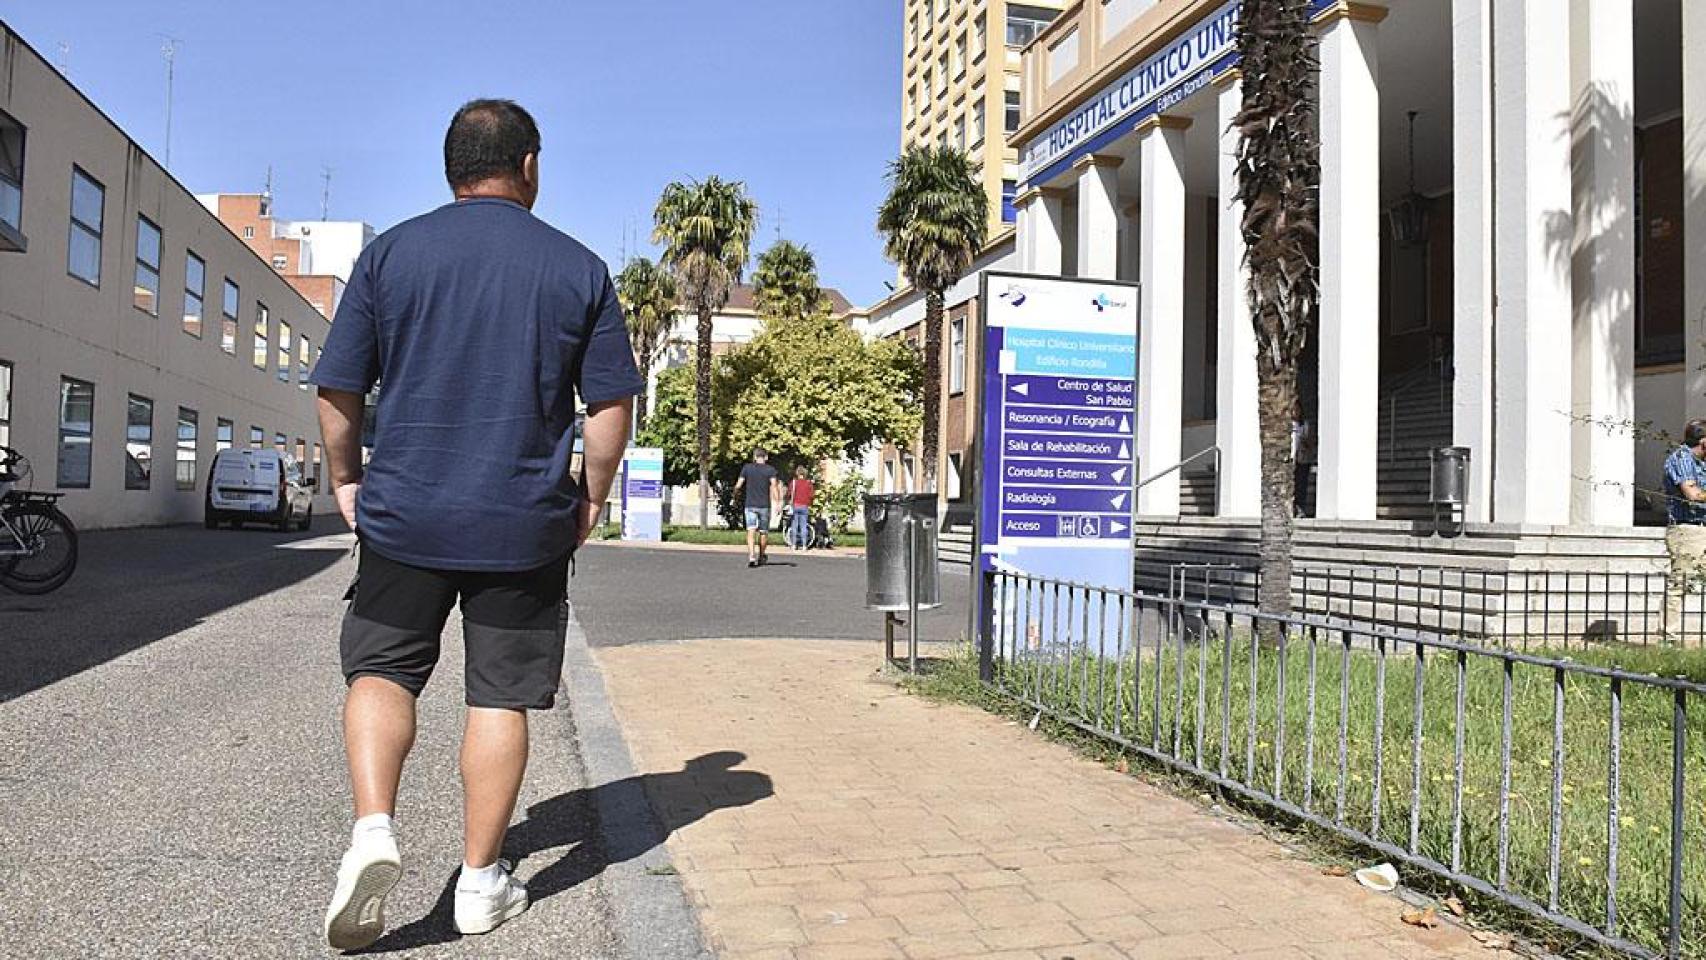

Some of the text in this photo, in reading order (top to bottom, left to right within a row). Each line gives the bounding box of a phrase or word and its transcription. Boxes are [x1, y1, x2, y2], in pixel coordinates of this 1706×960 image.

[1049, 3, 1240, 156] HOSPITAL CLÍNICO UNI
[1058, 379, 1132, 393] Centro de Salud
[1086, 394, 1132, 406] San Pablo
[1009, 412, 1116, 428] Resonancia / Ecografía
[1008, 440, 1111, 454] Sala de Rehabilitación
[1007, 466, 1097, 479] Consultas Externas
[1006, 493, 1056, 505] Radiología
[1006, 520, 1040, 531] Acceso
